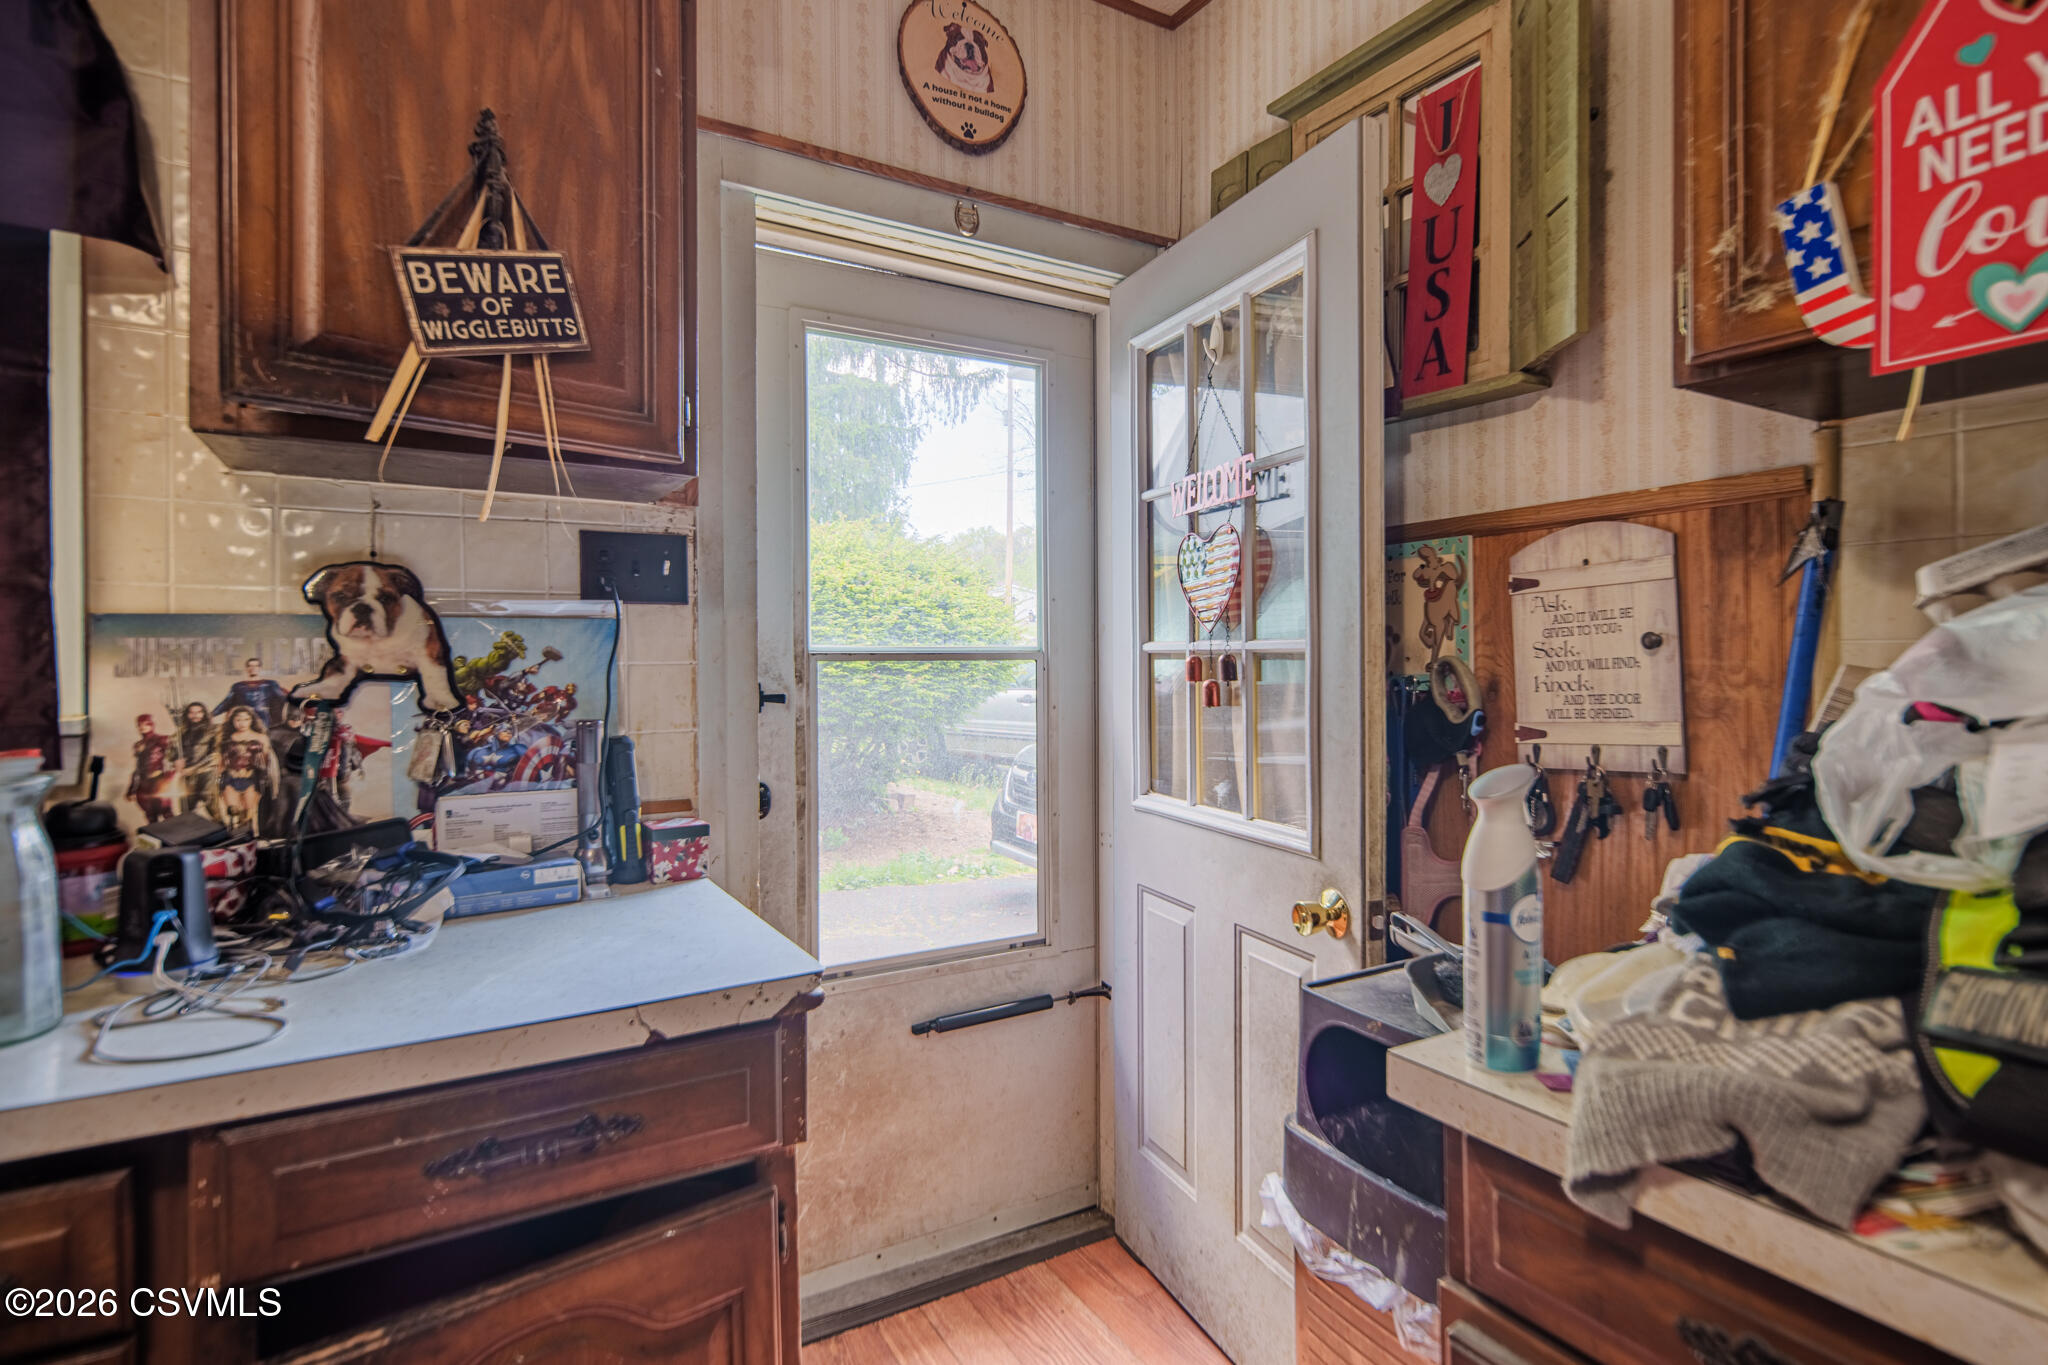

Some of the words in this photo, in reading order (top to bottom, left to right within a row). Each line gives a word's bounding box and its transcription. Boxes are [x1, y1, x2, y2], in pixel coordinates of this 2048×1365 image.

[923, 82, 930, 90] A
[932, 83, 958, 97] house
[960, 90, 967, 99] is
[968, 95, 983, 104] not
[990, 100, 1012, 113] home
[932, 96, 966, 110] without
[974, 106, 1005, 123] bulldog
[1902, 70, 2013, 149] ALL
[1440, 97, 1456, 151] I
[406, 260, 566, 295] BEWARE
[481, 297, 513, 316] OF
[1413, 204, 1465, 383] USA
[421, 317, 578, 341] WIGGLEBUTTS
[1171, 453, 1257, 519] WELCOME
[1552, 613, 1575, 625] AND
[1576, 611, 1586, 623] IT
[1588, 609, 1617, 622] WILL
[1619, 607, 1634, 619] BE
[1542, 626, 1575, 639] GIVEN
[1576, 625, 1592, 636] TO
[113, 636, 244, 678] JUSTICE
[1545, 660, 1565, 673] AND
[1566, 659, 1585, 671] YOU
[1587, 658, 1610, 670] WILL
[1562, 694, 1585, 706] AND
[1587, 693, 1607, 705] THE
[1609, 692, 1642, 705] DOOR
[1545, 708, 1572, 720] WILL
[1574, 708, 1587, 719] BE
